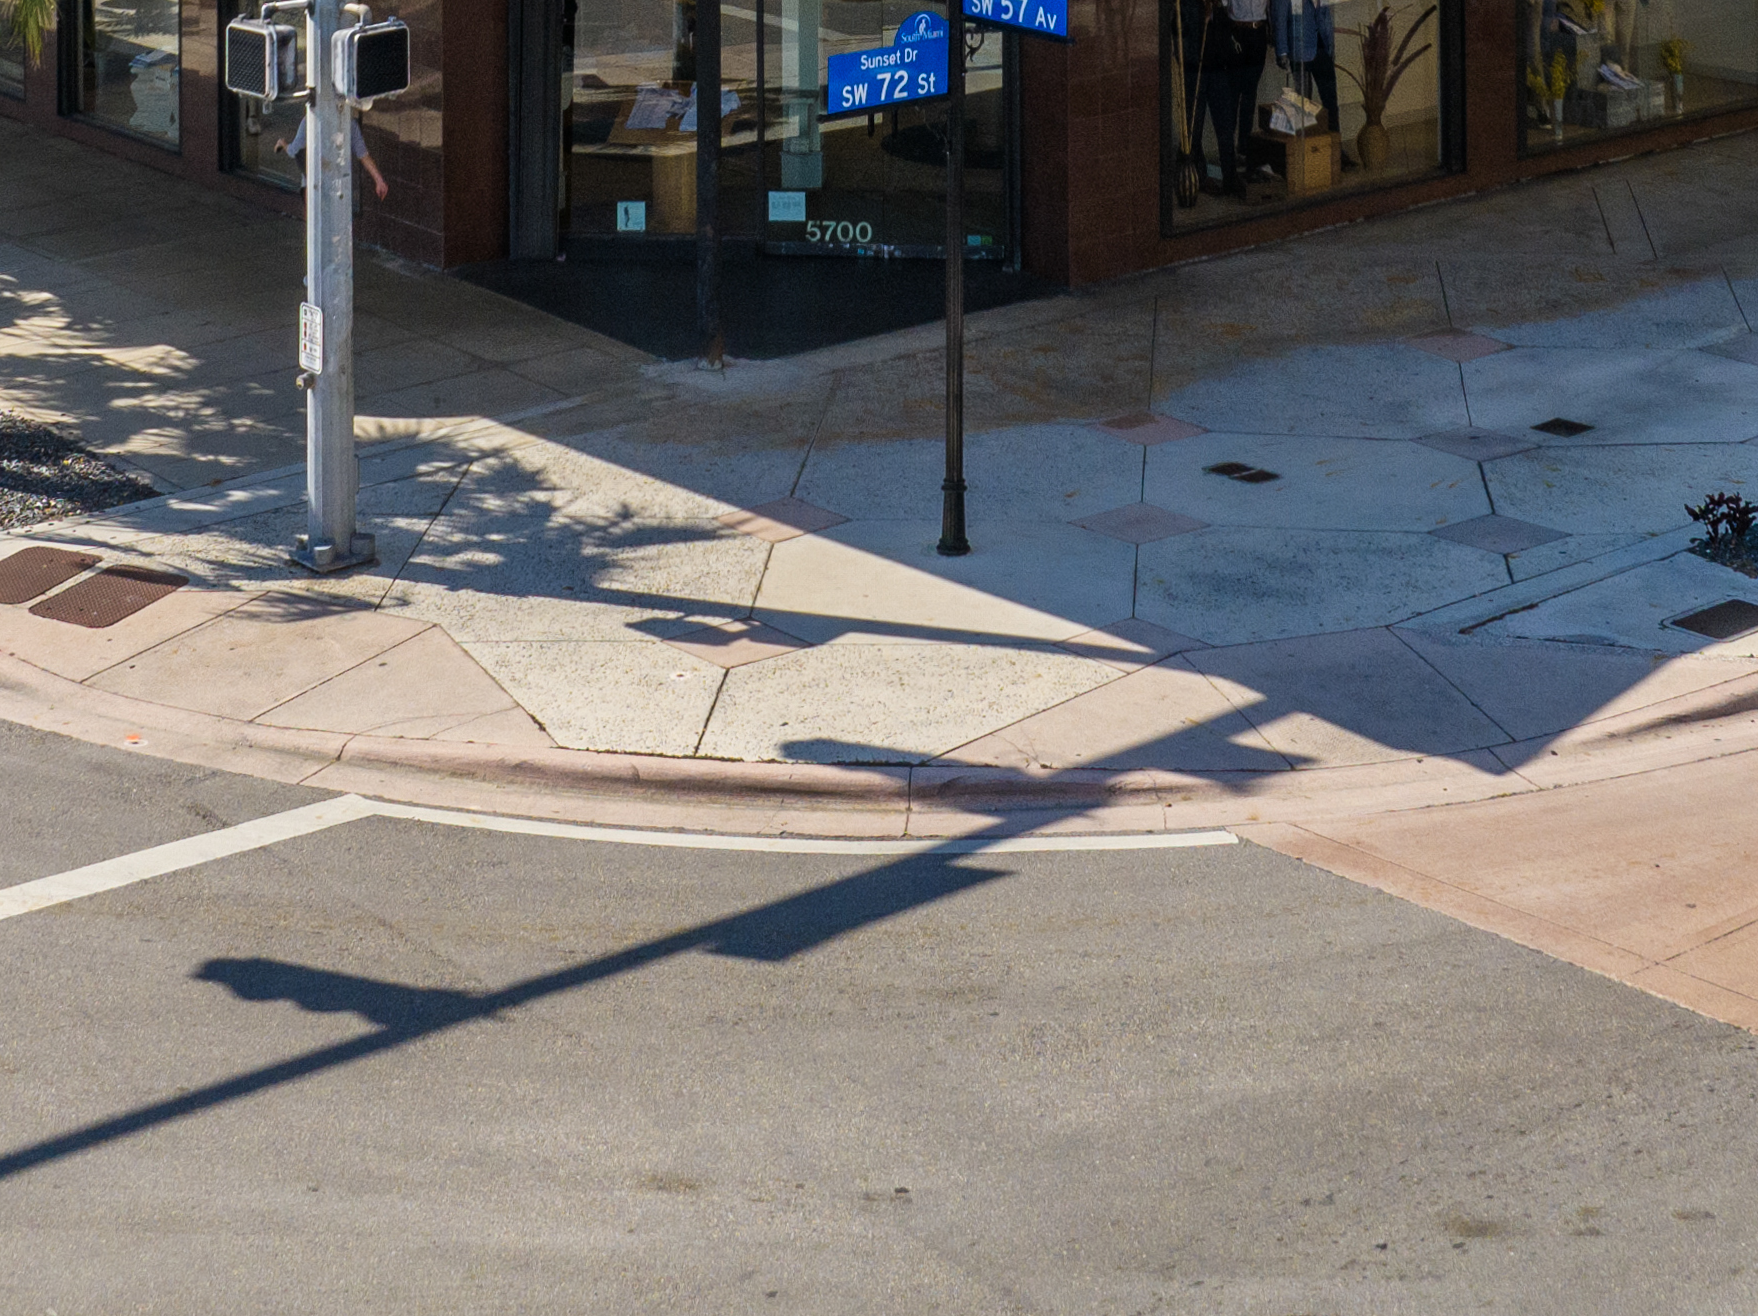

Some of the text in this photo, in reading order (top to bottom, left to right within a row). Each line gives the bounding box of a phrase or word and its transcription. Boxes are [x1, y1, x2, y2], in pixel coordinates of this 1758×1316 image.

[860, 47, 918, 70] Sunset Dr
[842, 70, 935, 108] SW 72 St
[805, 220, 873, 243] 5700
